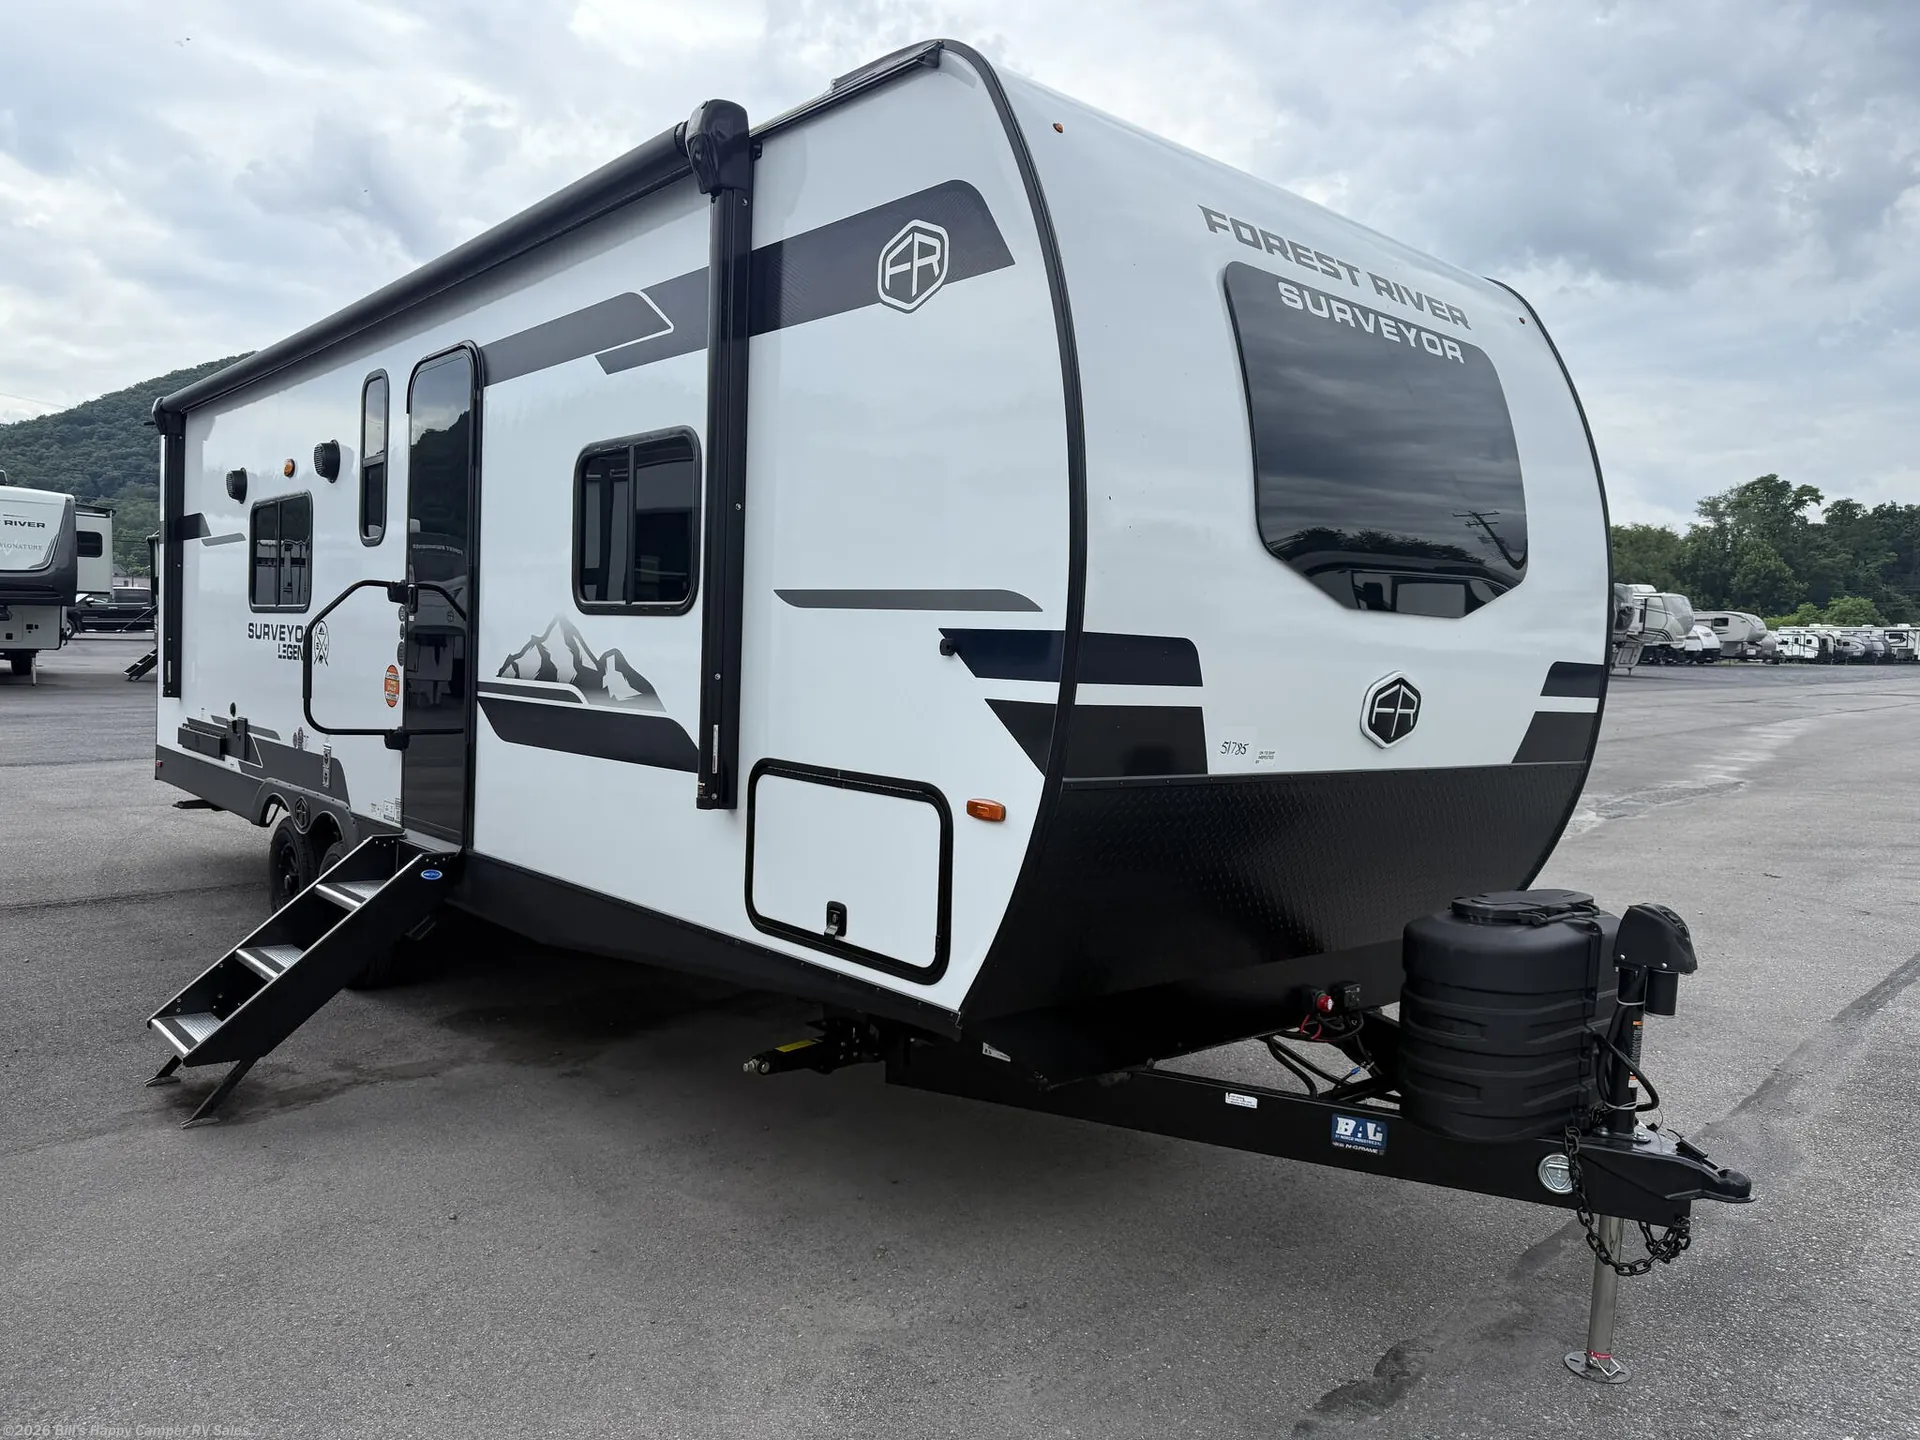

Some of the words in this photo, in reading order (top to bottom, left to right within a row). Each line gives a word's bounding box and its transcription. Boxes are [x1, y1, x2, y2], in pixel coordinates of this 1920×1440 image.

[1197, 203, 1360, 287] FOREST
[1366, 271, 1472, 331] RIVER
[1277, 281, 1465, 364] SURVEYOR
[4, 519, 46, 529] RIVER
[248, 622, 308, 643] SURVEYO
[277, 643, 304, 661] LEGEN
[1220, 740, 1250, 756] 51785
